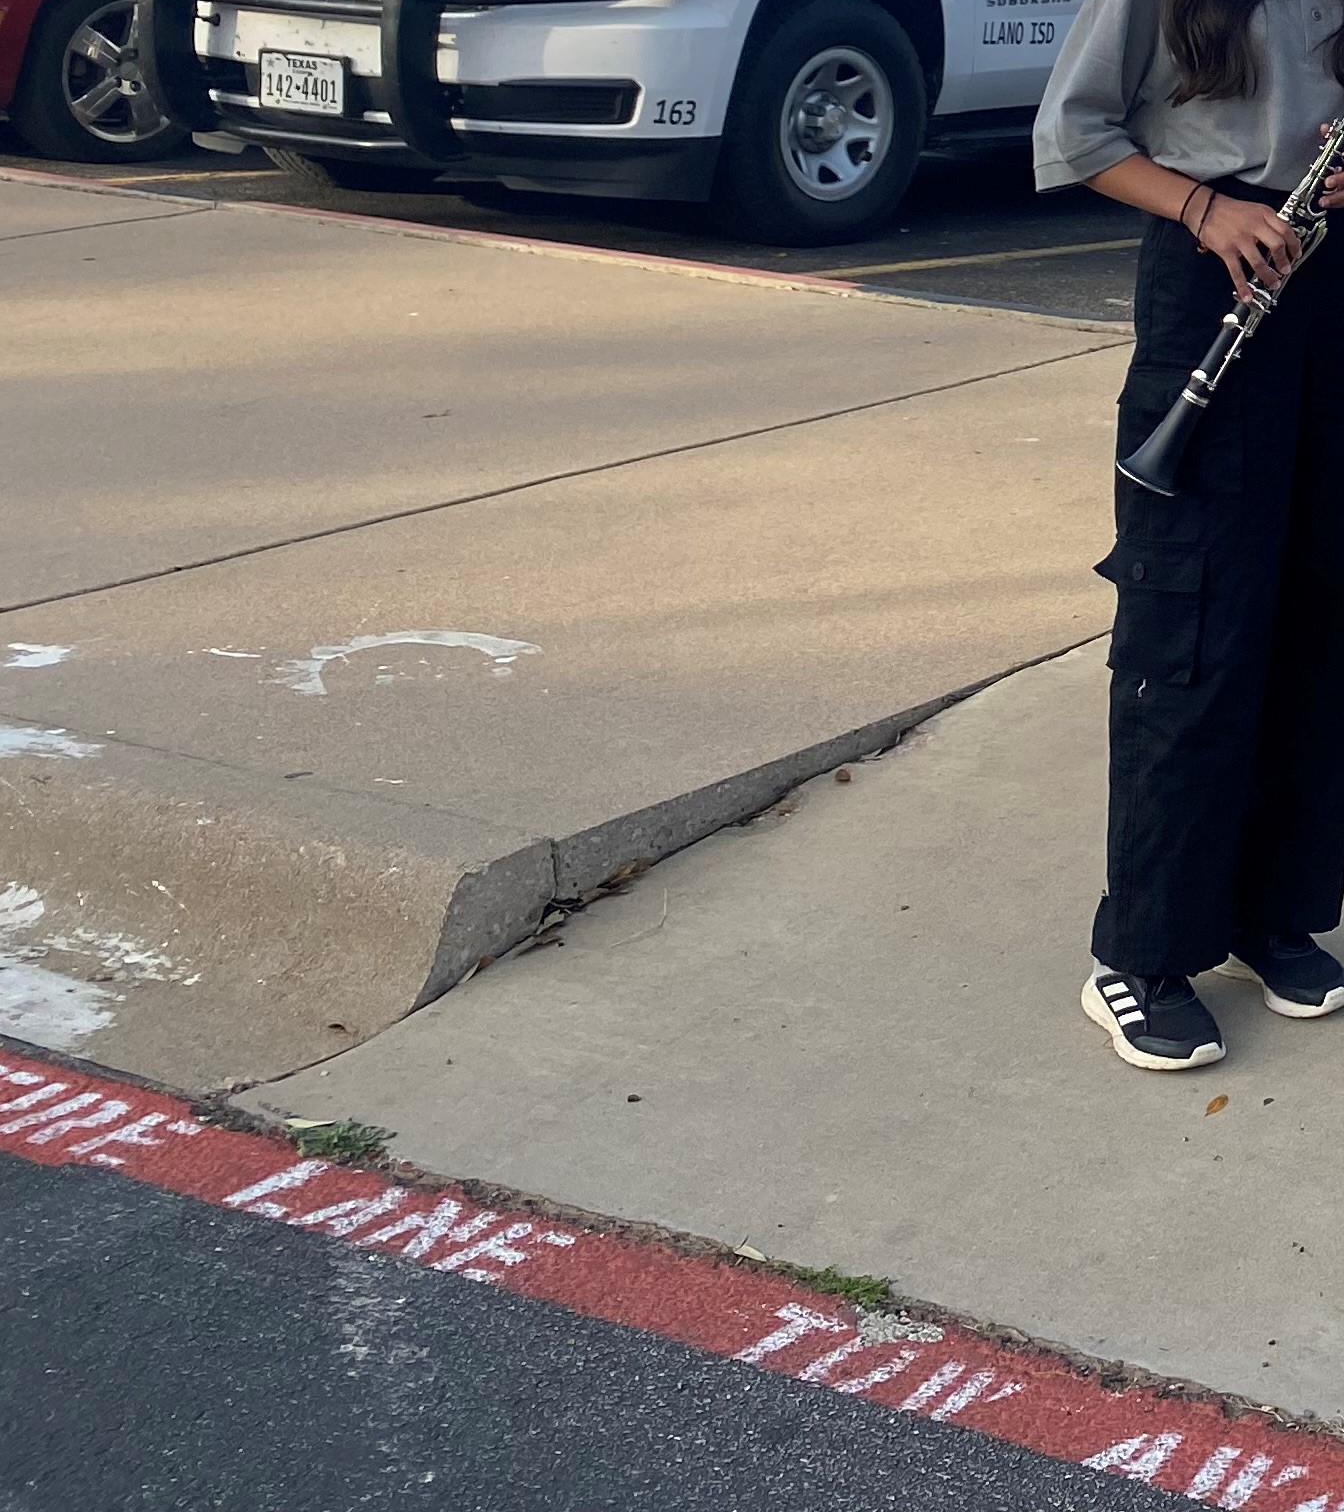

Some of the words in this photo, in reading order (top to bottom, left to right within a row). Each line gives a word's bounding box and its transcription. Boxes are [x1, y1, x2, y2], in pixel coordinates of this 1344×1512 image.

[982, 21, 1025, 45] LLANO
[1029, 21, 1055, 44] ISD
[287, 58, 318, 70] TEXAS
[653, 99, 697, 126] 163
[222, 1160, 577, 1283] LANE
